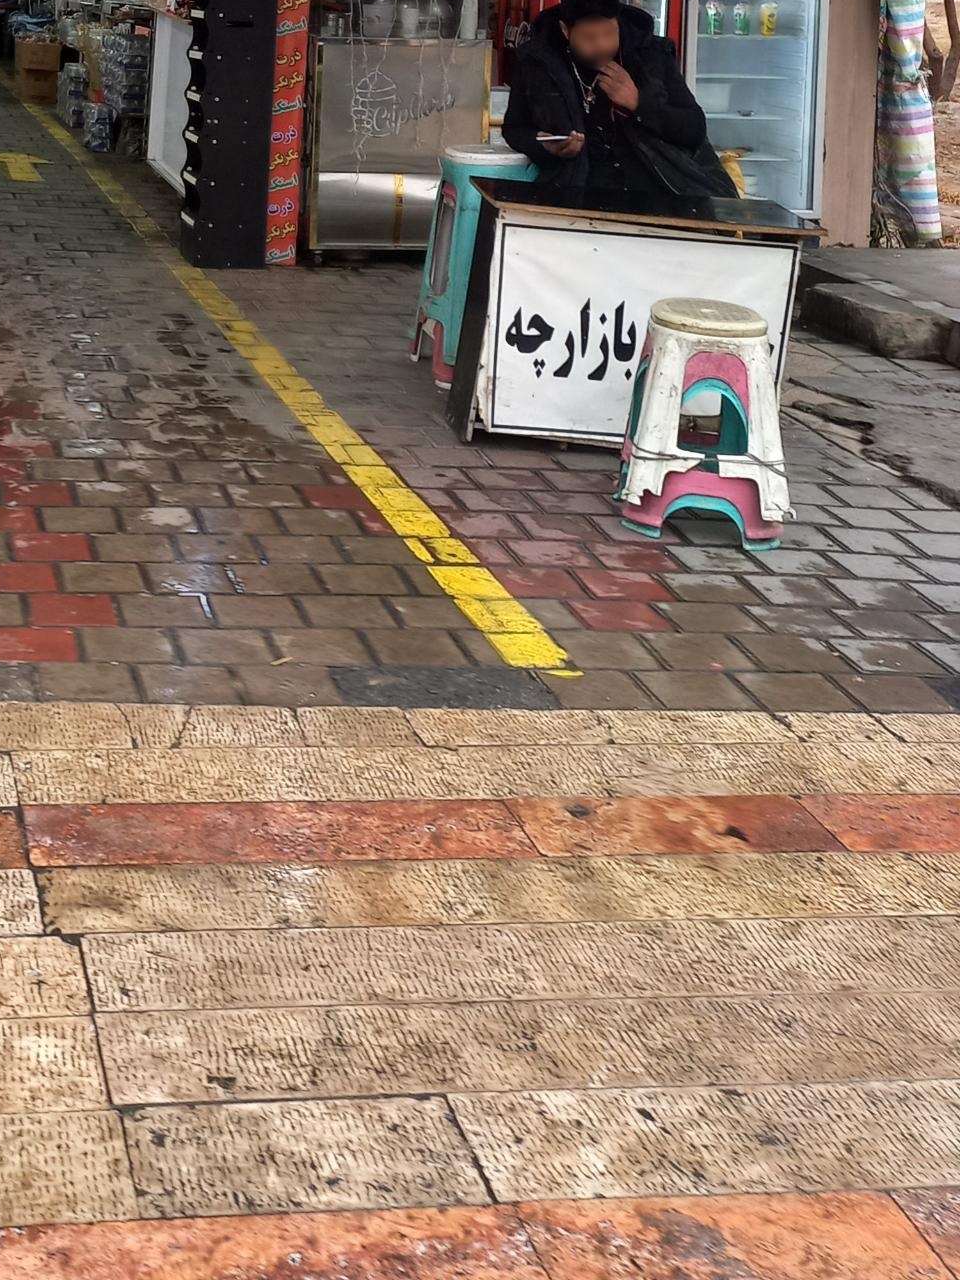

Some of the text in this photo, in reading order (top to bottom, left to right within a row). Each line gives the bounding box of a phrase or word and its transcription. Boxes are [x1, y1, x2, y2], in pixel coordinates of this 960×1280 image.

[276, 48, 302, 65] ذرت
[270, 125, 298, 144] ذرت
[267, 197, 295, 217] ذرت
[505, 297, 637, 381] بازارچه
